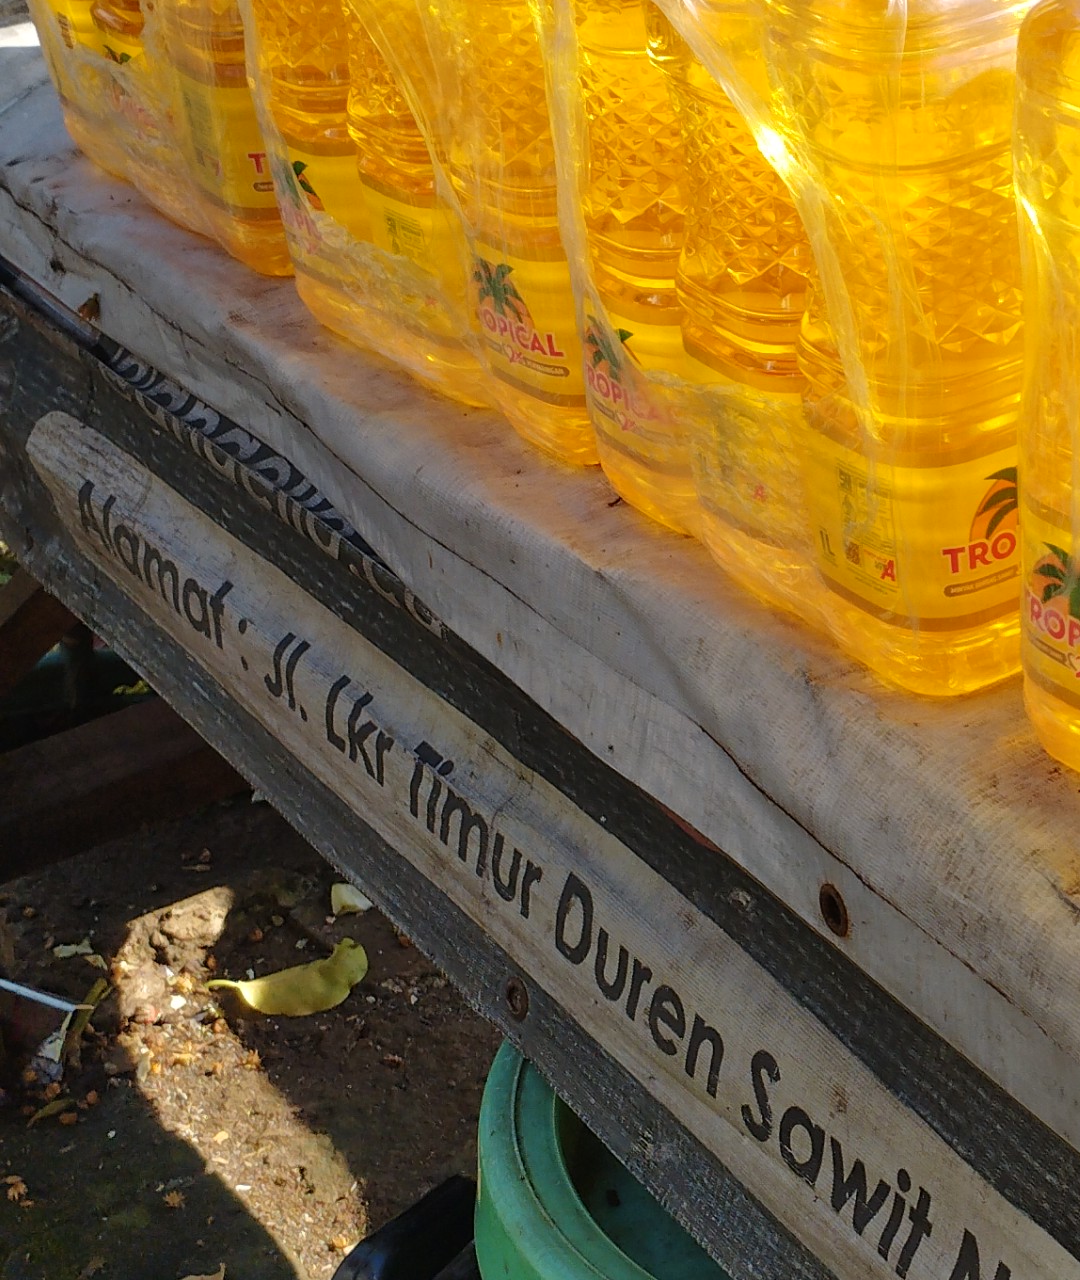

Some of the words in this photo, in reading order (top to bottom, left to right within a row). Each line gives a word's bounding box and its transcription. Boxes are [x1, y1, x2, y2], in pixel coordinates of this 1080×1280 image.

[325, 675, 394, 787] Lkr
[409, 740, 543, 919] Timur
[555, 871, 724, 1099] Duren
[741, 1050, 933, 1280] Sawit
